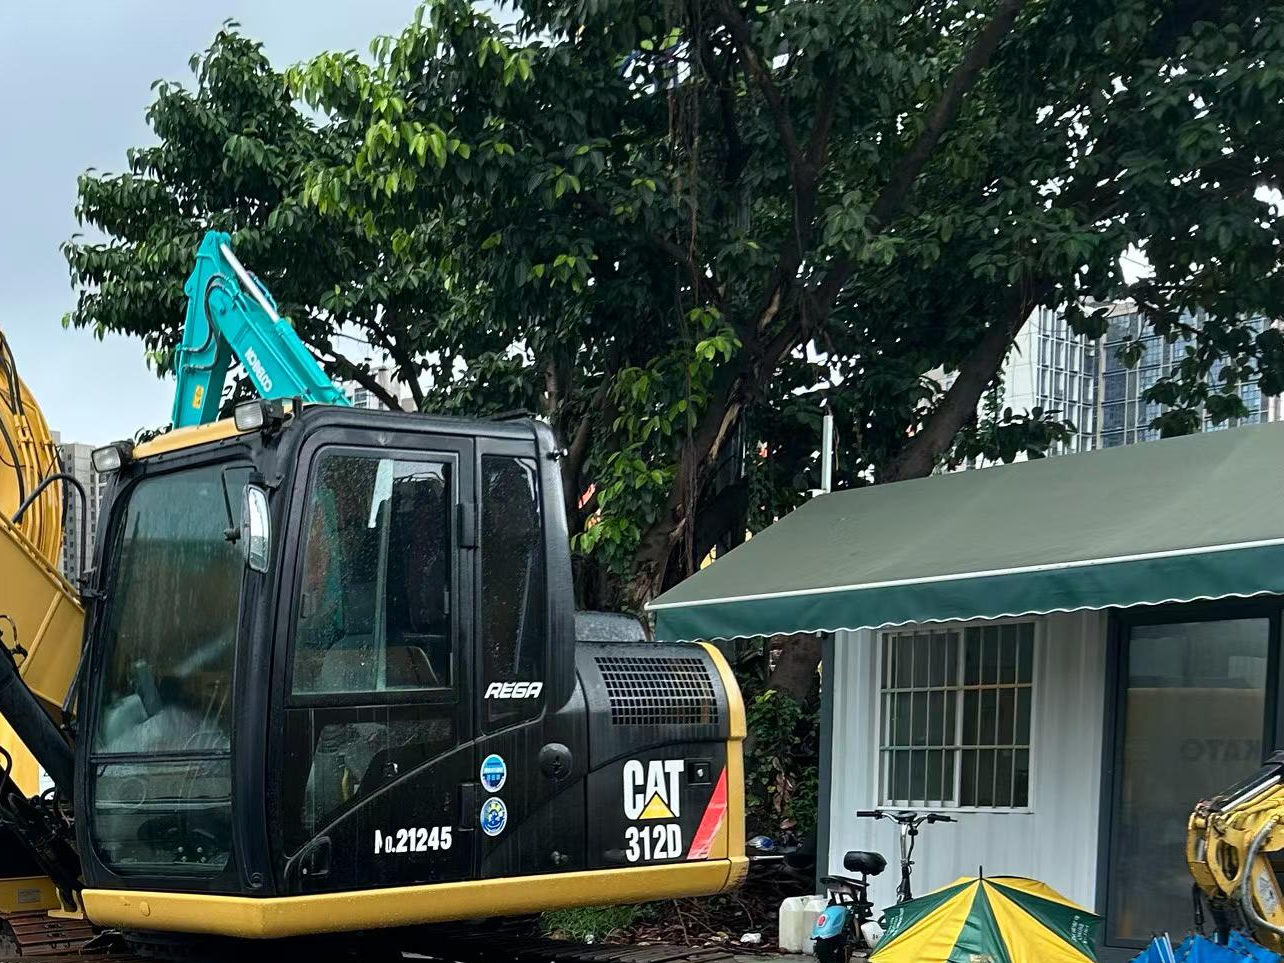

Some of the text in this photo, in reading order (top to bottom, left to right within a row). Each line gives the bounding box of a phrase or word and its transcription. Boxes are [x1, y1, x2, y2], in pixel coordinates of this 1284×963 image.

[245, 346, 272, 393] KOBELCO
[484, 682, 543, 699] REGA
[623, 760, 684, 820] CAT
[625, 824, 682, 862] 312D
